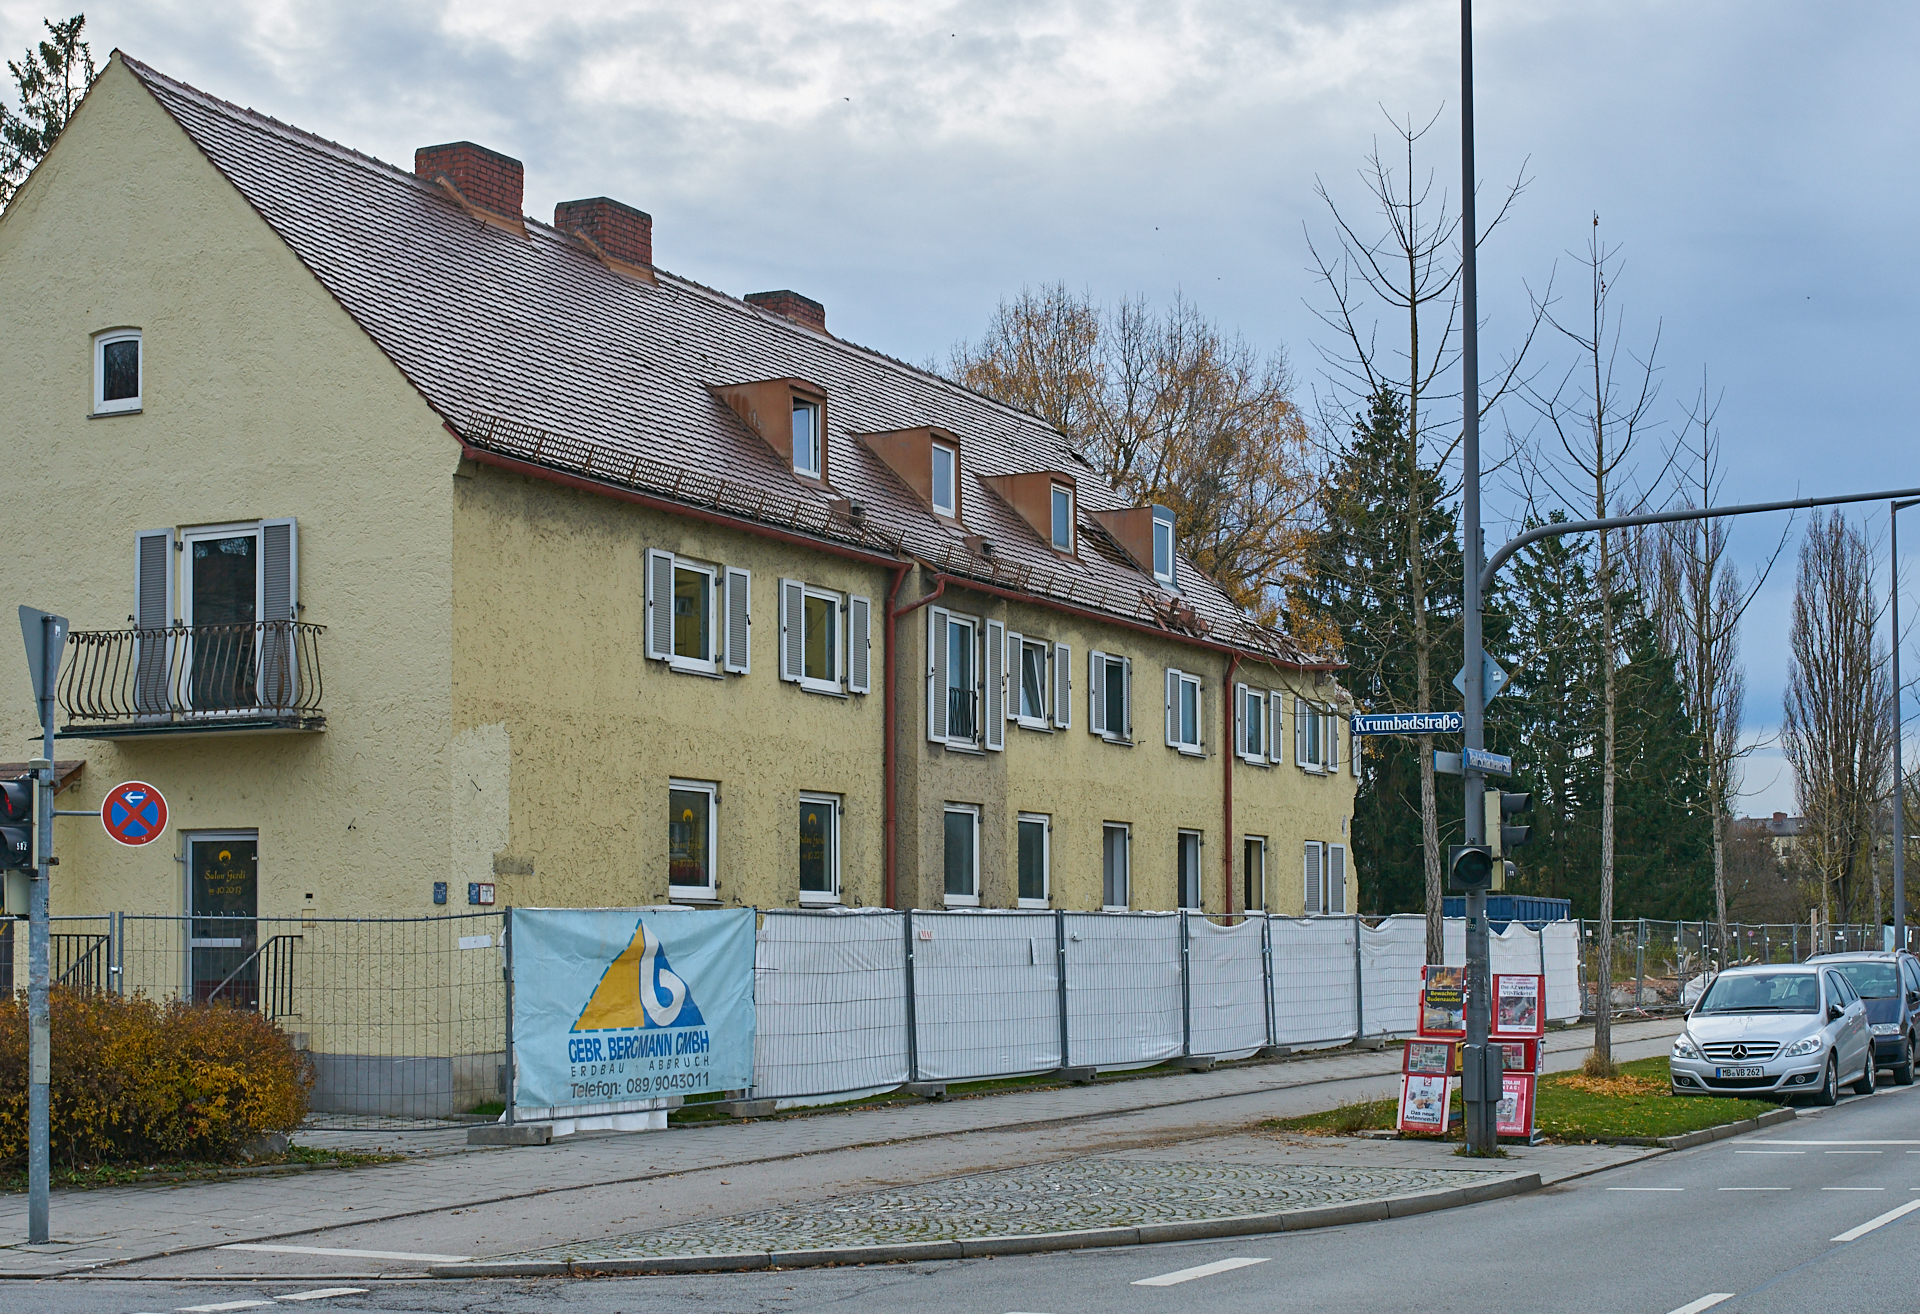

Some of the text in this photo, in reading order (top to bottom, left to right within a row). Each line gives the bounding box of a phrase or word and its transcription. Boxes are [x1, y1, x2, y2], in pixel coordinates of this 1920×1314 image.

[1355, 716, 1459, 732] Krumbadstraße
[204, 869, 246, 883] Salon Gerdi
[568, 1030, 710, 1063] GEBR. BERGMANN GMBH
[571, 1056, 710, 1078] ERDBAU ABBRUCH
[1722, 1068, 1760, 1077] MB VB 262
[570, 1072, 710, 1099] Telefon: 089/9043011
